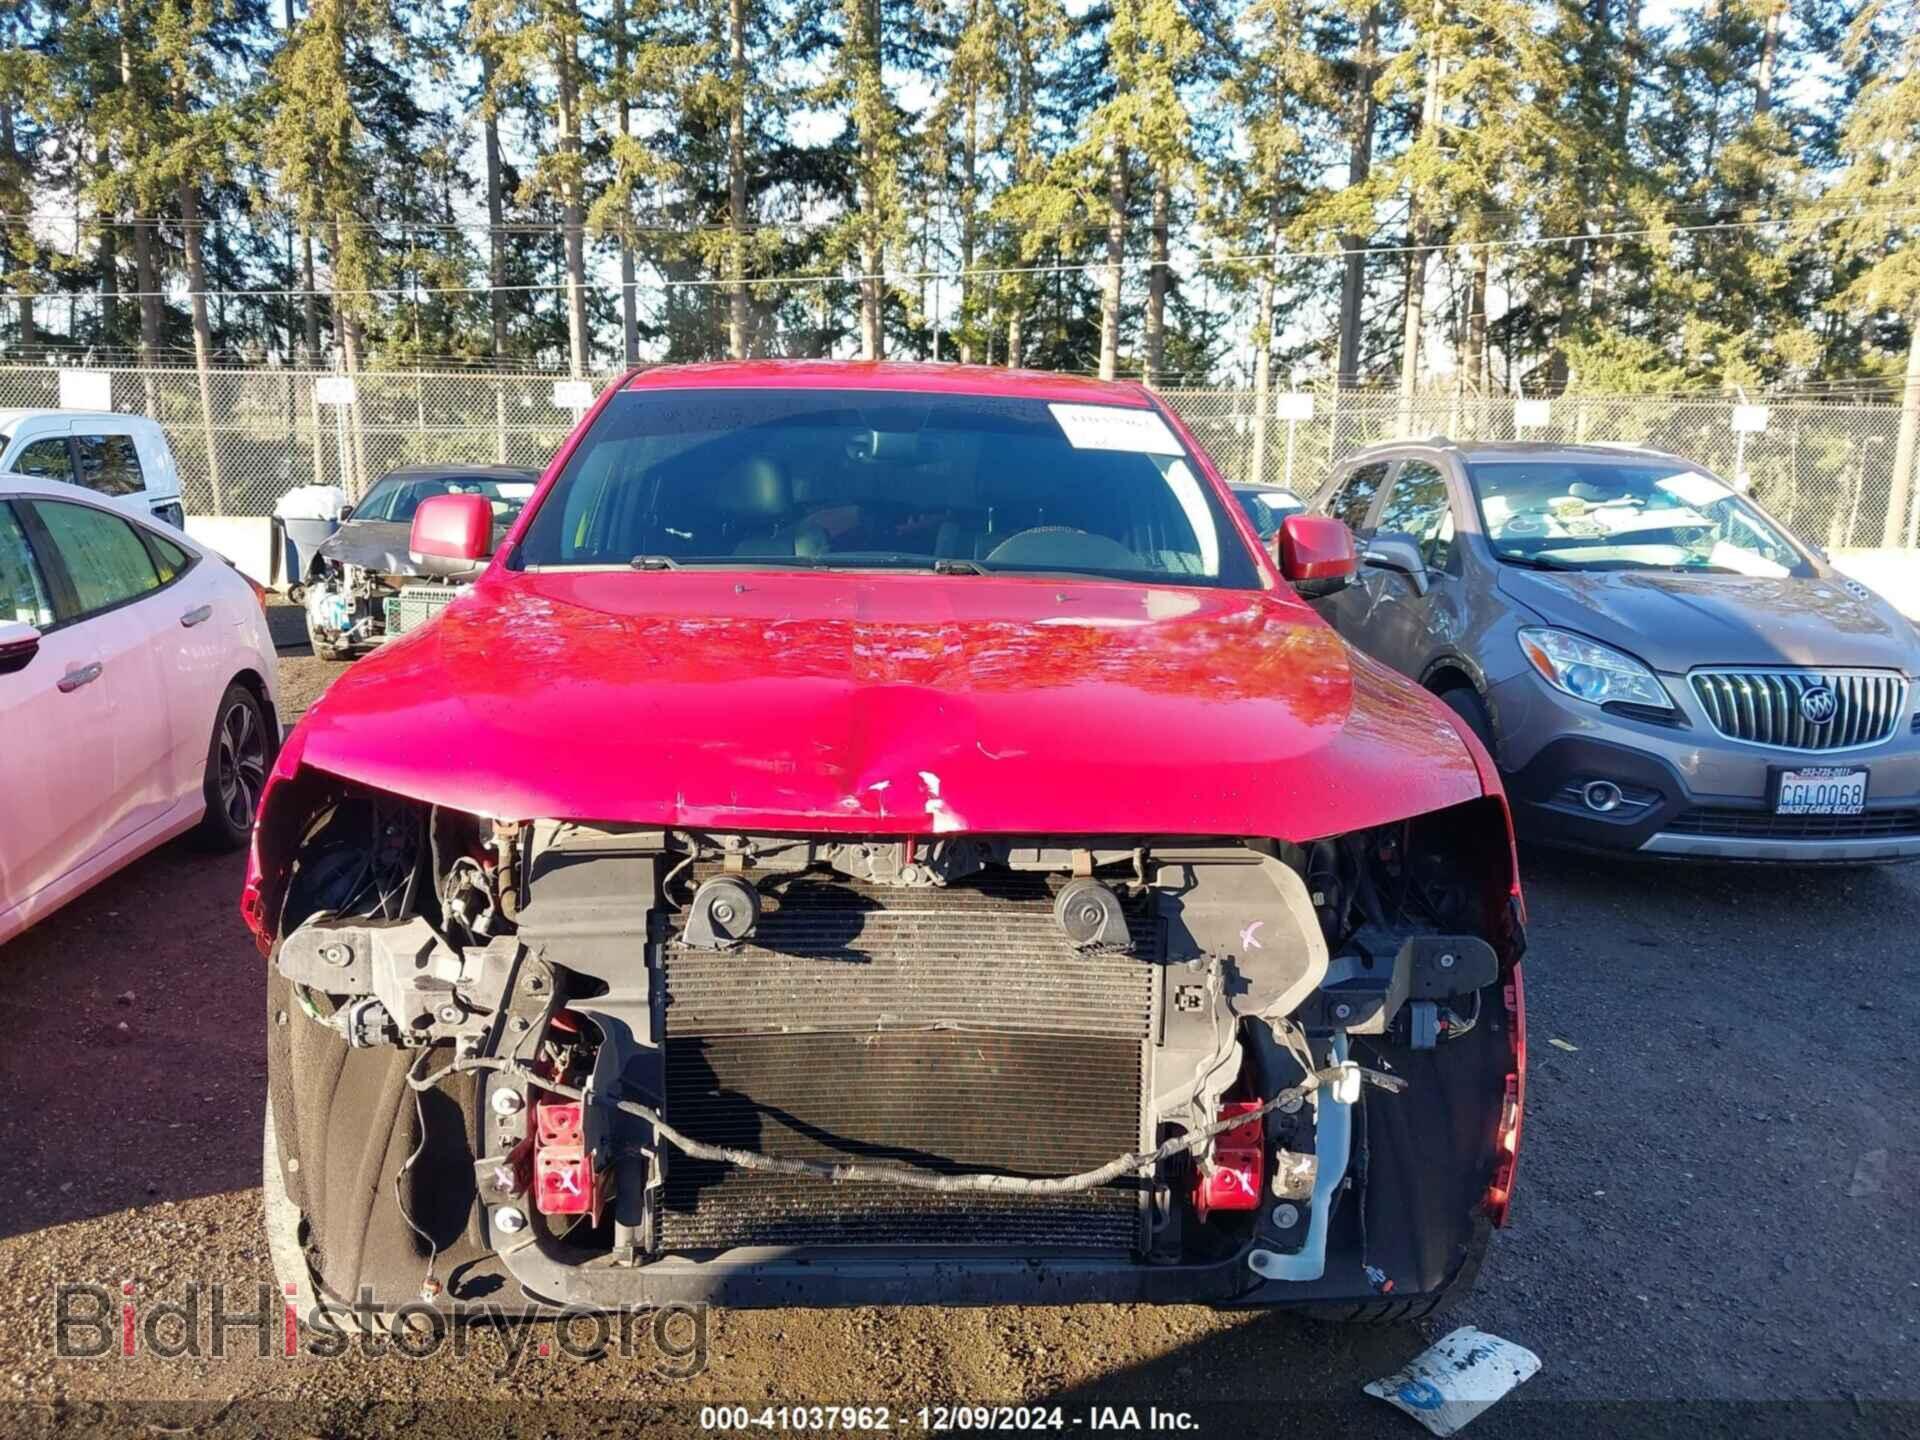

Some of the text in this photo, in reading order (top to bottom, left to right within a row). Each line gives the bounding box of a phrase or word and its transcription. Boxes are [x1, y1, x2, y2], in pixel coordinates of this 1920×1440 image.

[1781, 784, 1862, 805] CGL0068
[1776, 805, 1864, 814] SUNSET CARS SELECT
